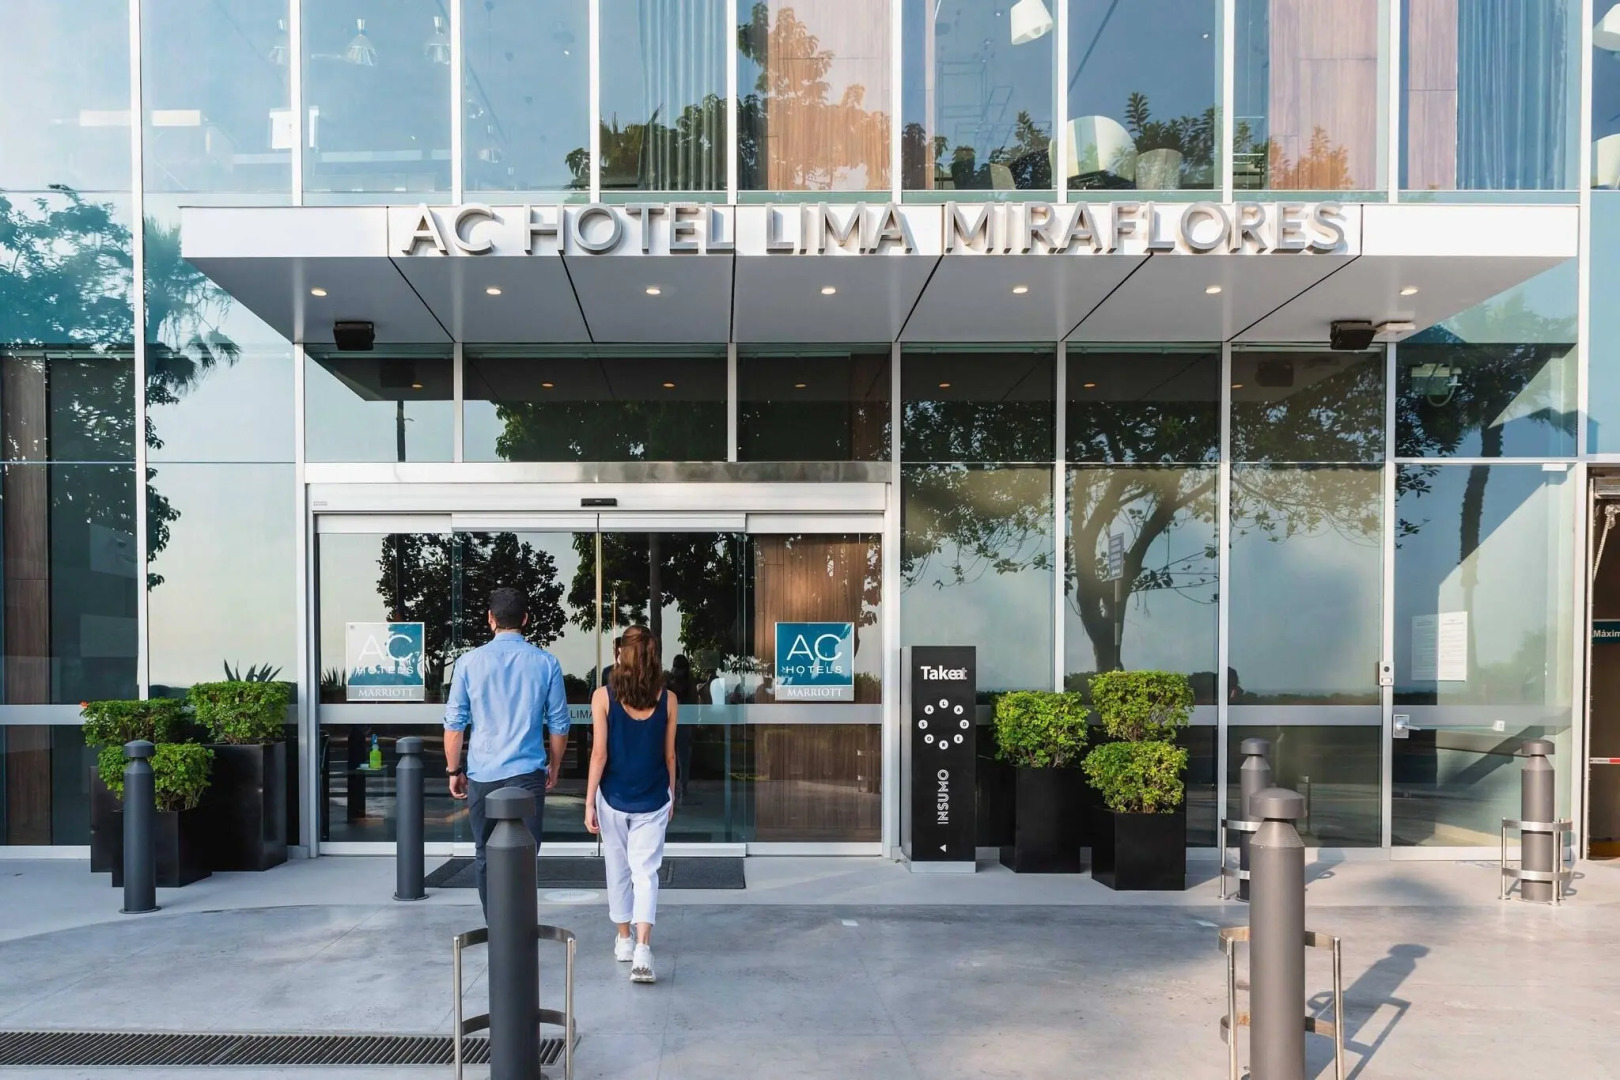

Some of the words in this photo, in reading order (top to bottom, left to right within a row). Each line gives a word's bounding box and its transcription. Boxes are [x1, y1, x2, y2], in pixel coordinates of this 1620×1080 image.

[401, 203, 495, 256] AC
[523, 202, 733, 256] HOTEL
[765, 202, 914, 255] LIMA
[945, 201, 1346, 256] MIRAFLORES
[357, 633, 414, 661] AC
[786, 633, 843, 661] AC
[356, 665, 414, 675] HOTELS
[785, 665, 843, 674] HOTELS
[358, 688, 414, 697] MARRIOTT
[787, 688, 843, 697] MARRIOTT
[937, 768, 950, 825] INSUMO
